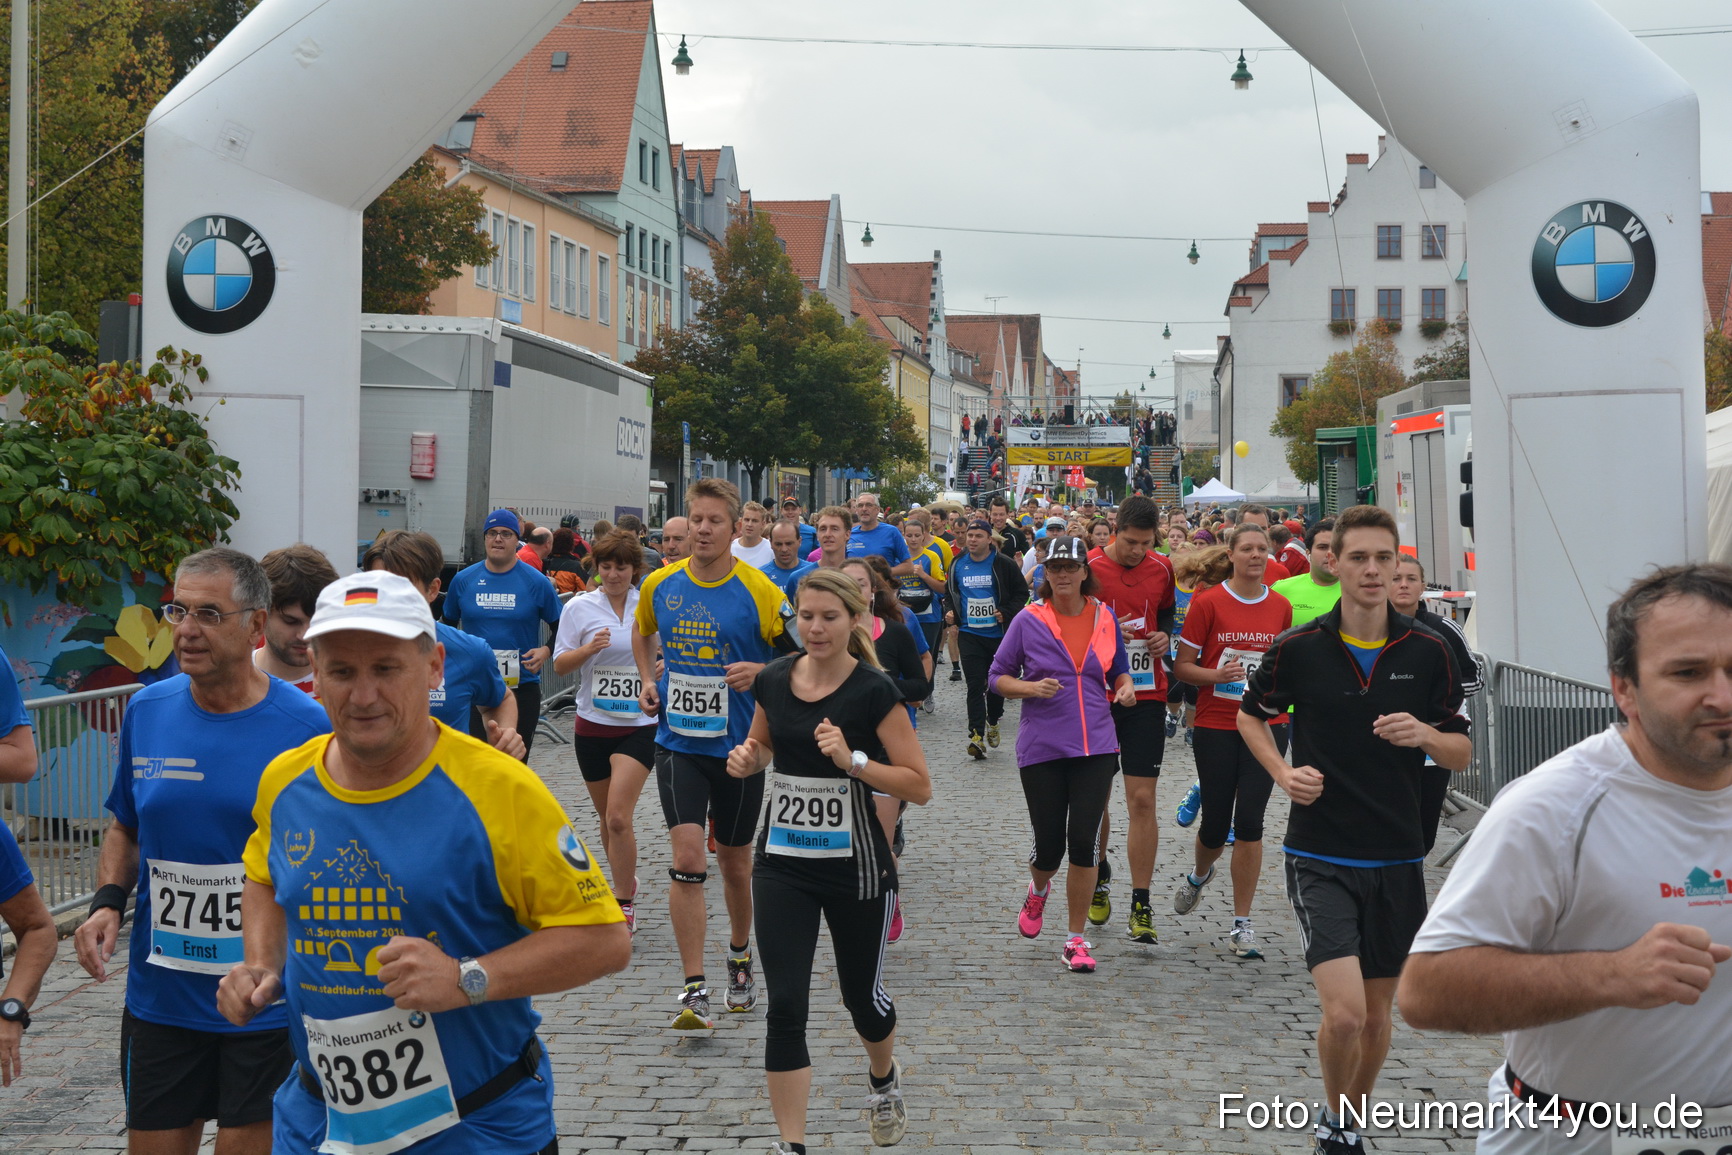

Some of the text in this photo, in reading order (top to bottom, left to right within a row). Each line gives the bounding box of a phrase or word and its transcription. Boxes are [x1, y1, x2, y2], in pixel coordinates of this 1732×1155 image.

[1541, 203, 1647, 246] BMW
[174, 218, 267, 258] BMW
[617, 416, 645, 460] BOCK
[1047, 450, 1091, 461] START
[963, 575, 992, 583] HUBER
[476, 593, 516, 602] HUBER
[970, 604, 994, 617] 2860
[1217, 632, 1276, 643] NEUMARKT
[594, 669, 613, 677] PARTL
[598, 678, 642, 698] 2530
[670, 677, 716, 689] PARTL Neumarkt
[610, 703, 629, 711] Julia
[672, 688, 721, 714] 2654
[682, 718, 707, 729] Oliver
[774, 781, 835, 794] PARTL Neumarkt
[778, 795, 843, 828] 2299
[294, 833, 303, 841] 15
[787, 833, 829, 847] Melanie
[288, 844, 307, 853] Jahre
[182, 874, 237, 887] Neumarkt
[1659, 882, 1686, 899] Die
[159, 887, 243, 932] 2745
[183, 940, 218, 960] Ernst
[308, 1021, 404, 1048] PARTL Neumarkt
[317, 1038, 433, 1106] 3382
